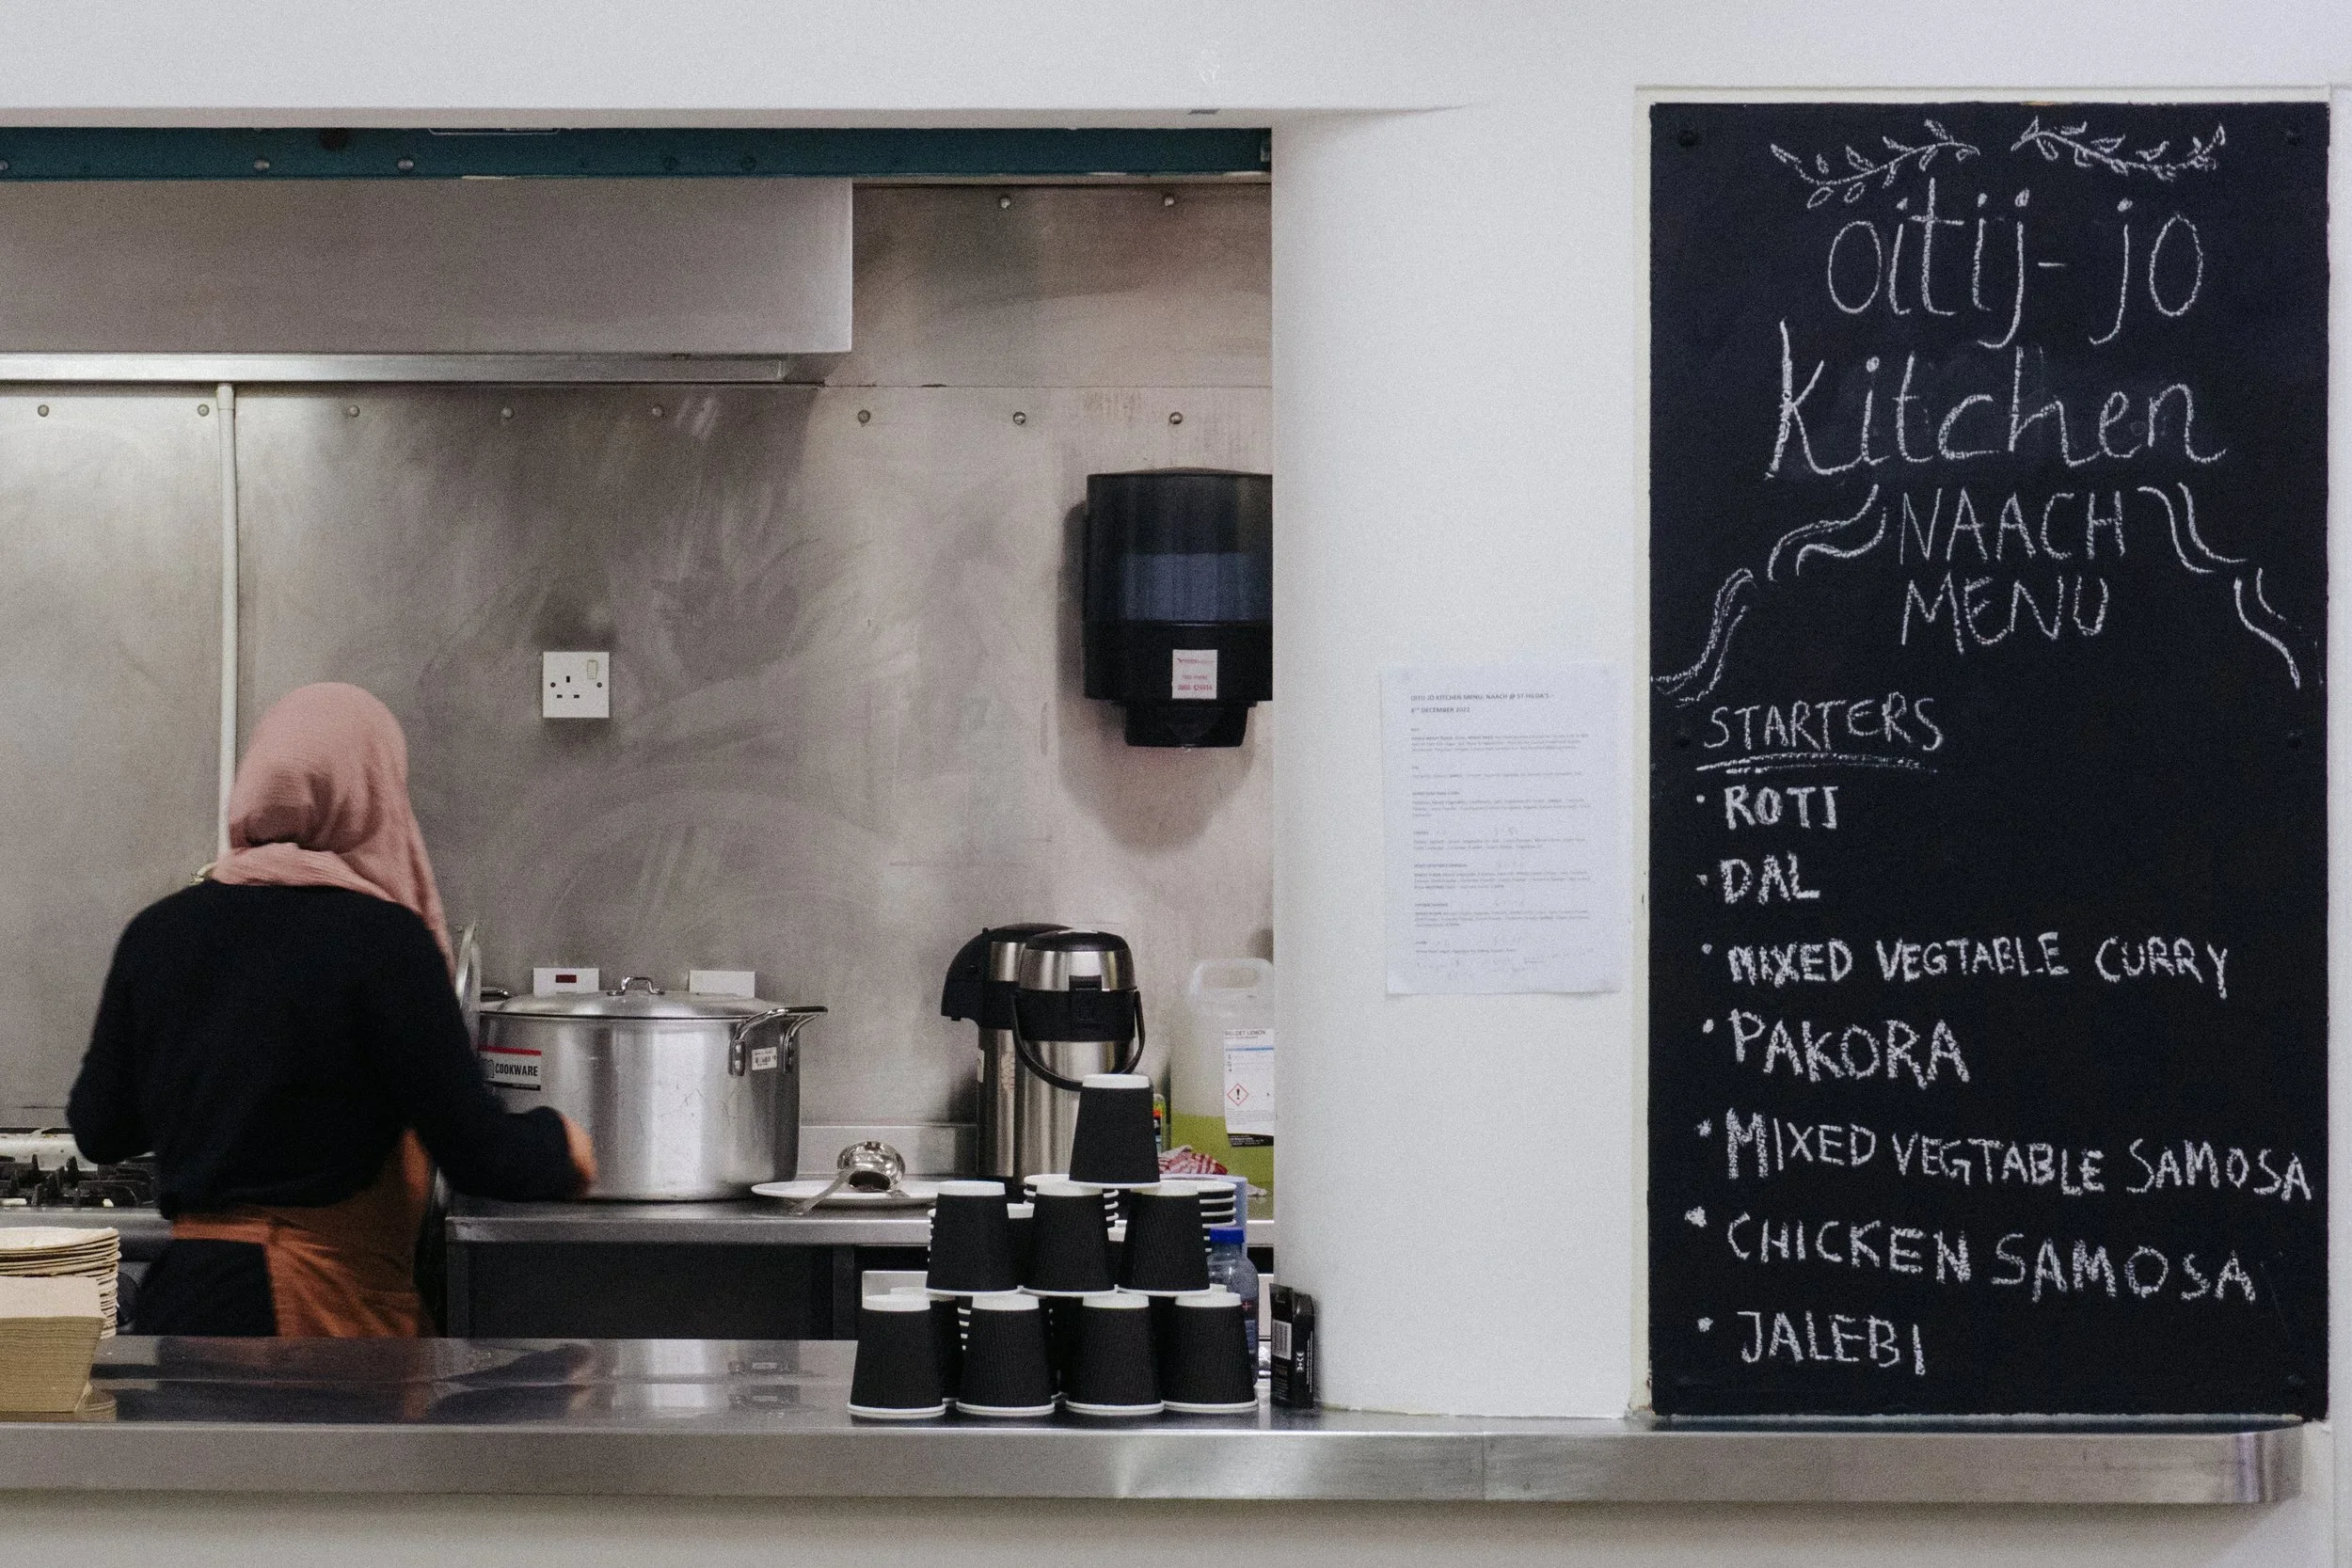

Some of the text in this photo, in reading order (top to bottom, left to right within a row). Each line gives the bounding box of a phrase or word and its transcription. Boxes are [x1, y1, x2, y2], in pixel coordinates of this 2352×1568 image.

[1899, 487, 2126, 566] NAACH
[1901, 573, 2108, 653] MENU
[1705, 694, 1943, 751] STARTERS
[1724, 784, 1838, 830] ROTI
[1720, 853, 1820, 904] DAL
[1727, 931, 2228, 999] MIXED VEGTABLE CURRY
[495, 1063, 538, 1077] COOKWARE
[1728, 1008, 1969, 1088] PAKORA
[1725, 1108, 2312, 1201] MIXED VEGTABLE SAMOSA
[1727, 1212, 2255, 1301] CHICKEN SAMOSA
[1738, 1311, 1926, 1375] JALEBI
